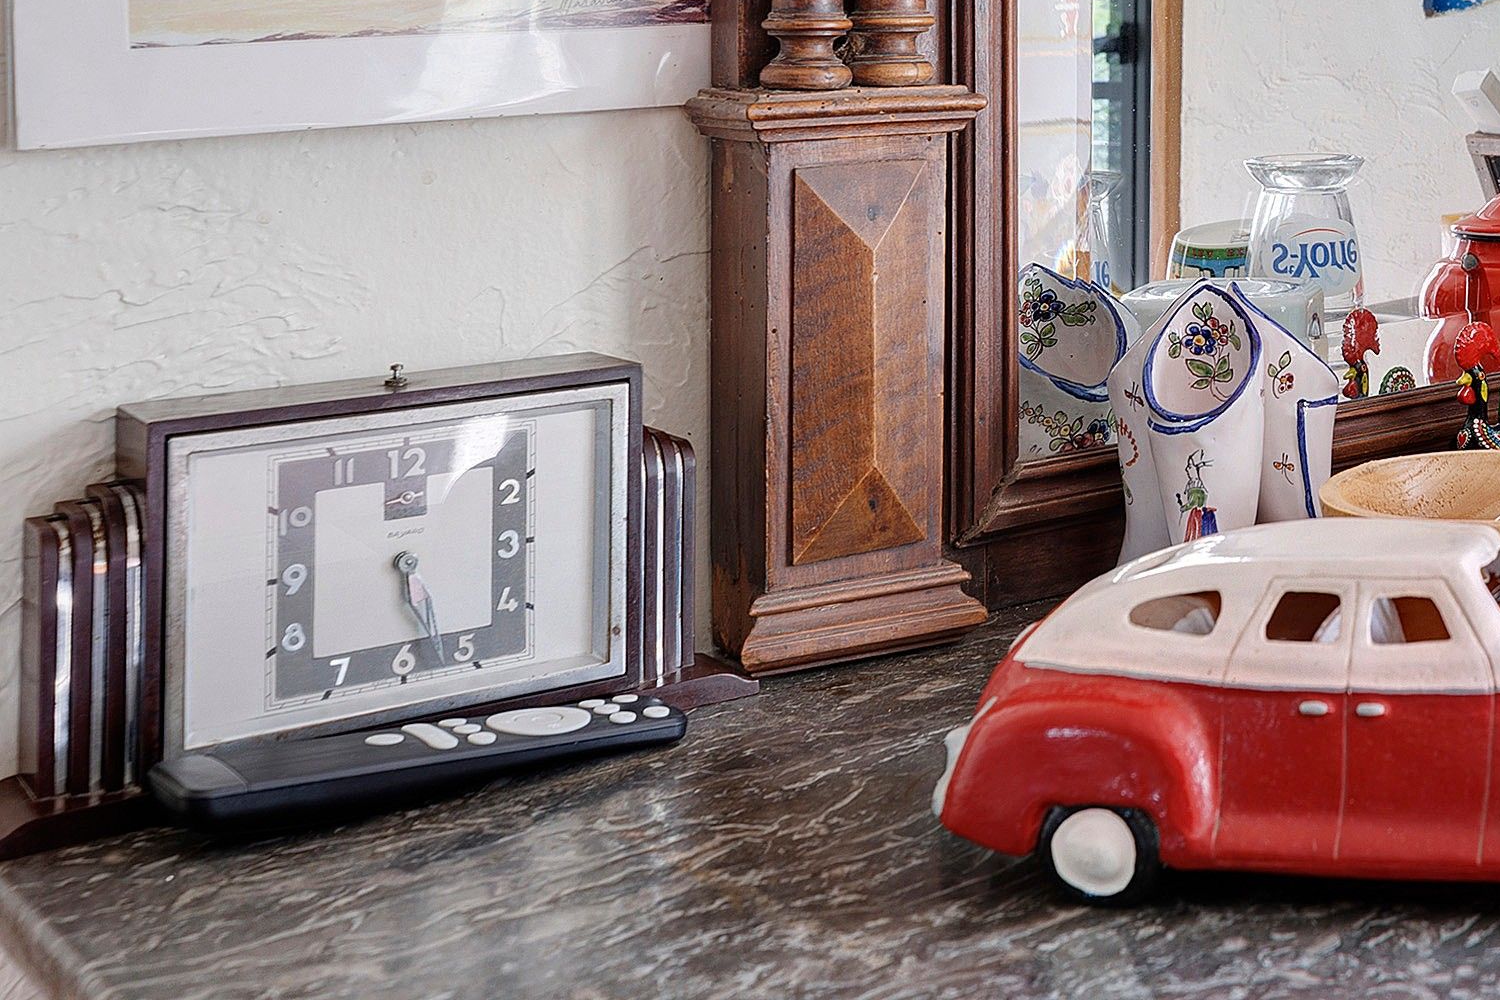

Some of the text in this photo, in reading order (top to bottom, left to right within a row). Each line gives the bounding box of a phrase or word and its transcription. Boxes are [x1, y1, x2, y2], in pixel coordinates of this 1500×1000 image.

[333, 457, 354, 486] 11
[387, 447, 427, 480] 12
[498, 478, 521, 506] 2
[279, 505, 313, 536] 10
[497, 529, 520, 559] 3
[281, 563, 308, 596] 9
[496, 586, 519, 612] 4
[281, 622, 306, 652] 8
[453, 633, 475, 662] 5
[328, 656, 351, 686] 7
[391, 643, 416, 676] 6
